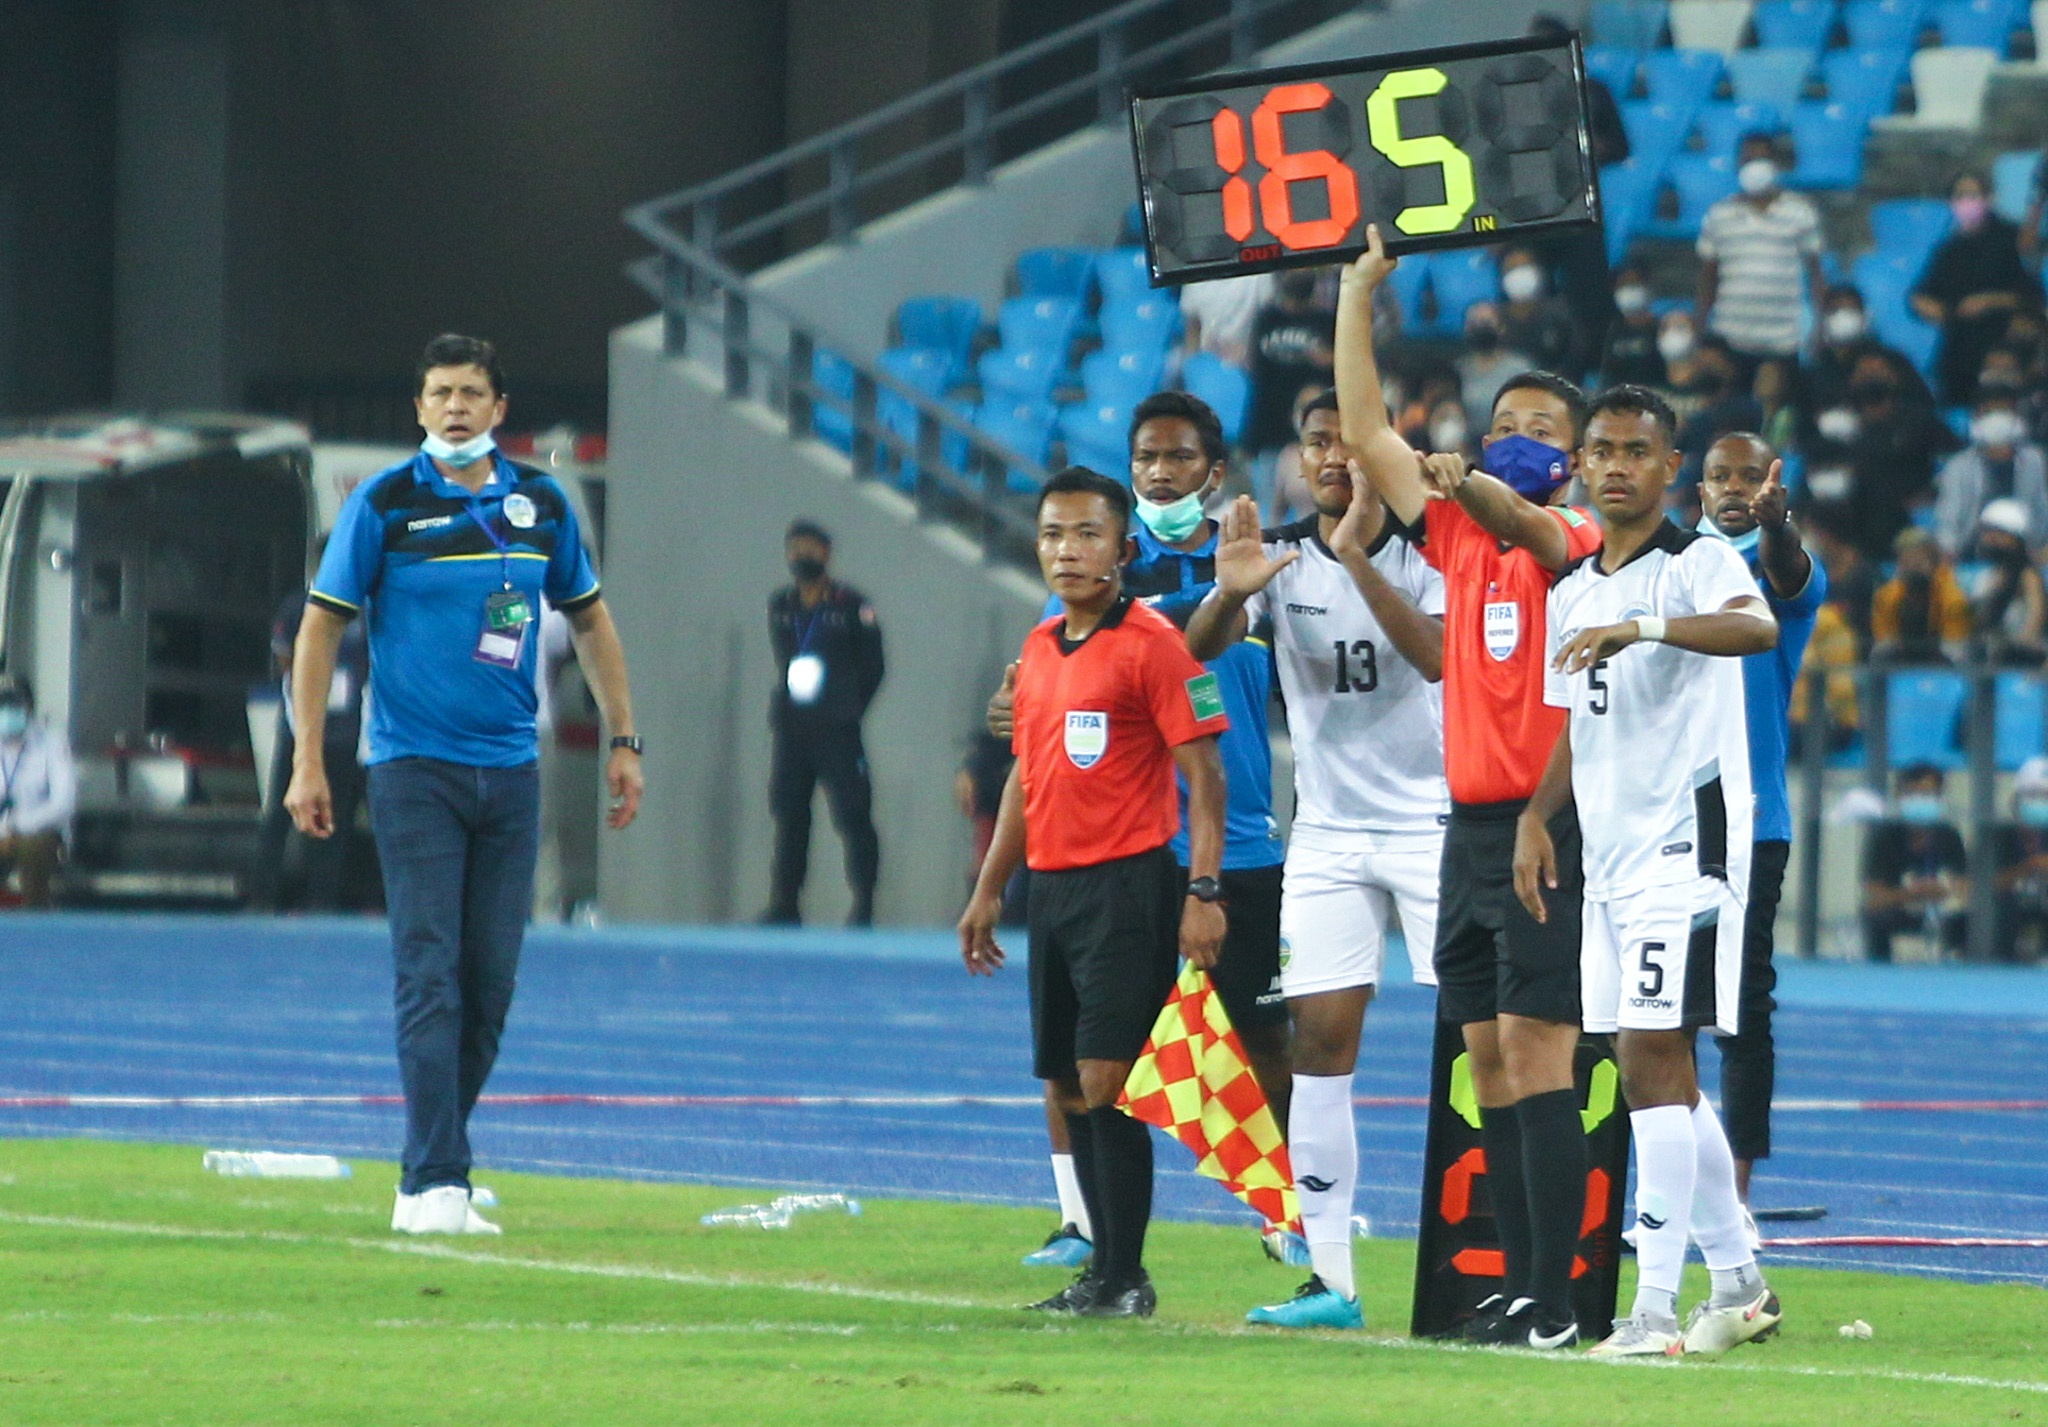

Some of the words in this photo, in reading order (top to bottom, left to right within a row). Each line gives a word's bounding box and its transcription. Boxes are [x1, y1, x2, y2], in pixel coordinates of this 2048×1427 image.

[1366, 67, 1477, 236] 5
[1212, 82, 1361, 252] 16
[1473, 215, 1496, 232] IN
[1240, 244, 1282, 263] OUT
[407, 515, 453, 532] narrow
[1286, 603, 1327, 616] narrow
[1487, 606, 1513, 620] FIFA
[1333, 640, 1378, 693] 13
[1587, 660, 1608, 715] 5
[1069, 715, 1102, 728] FIFA
[1637, 941, 1667, 998] 5
[1255, 994, 1284, 1006] narro
[1627, 998, 1673, 1009] narrow
